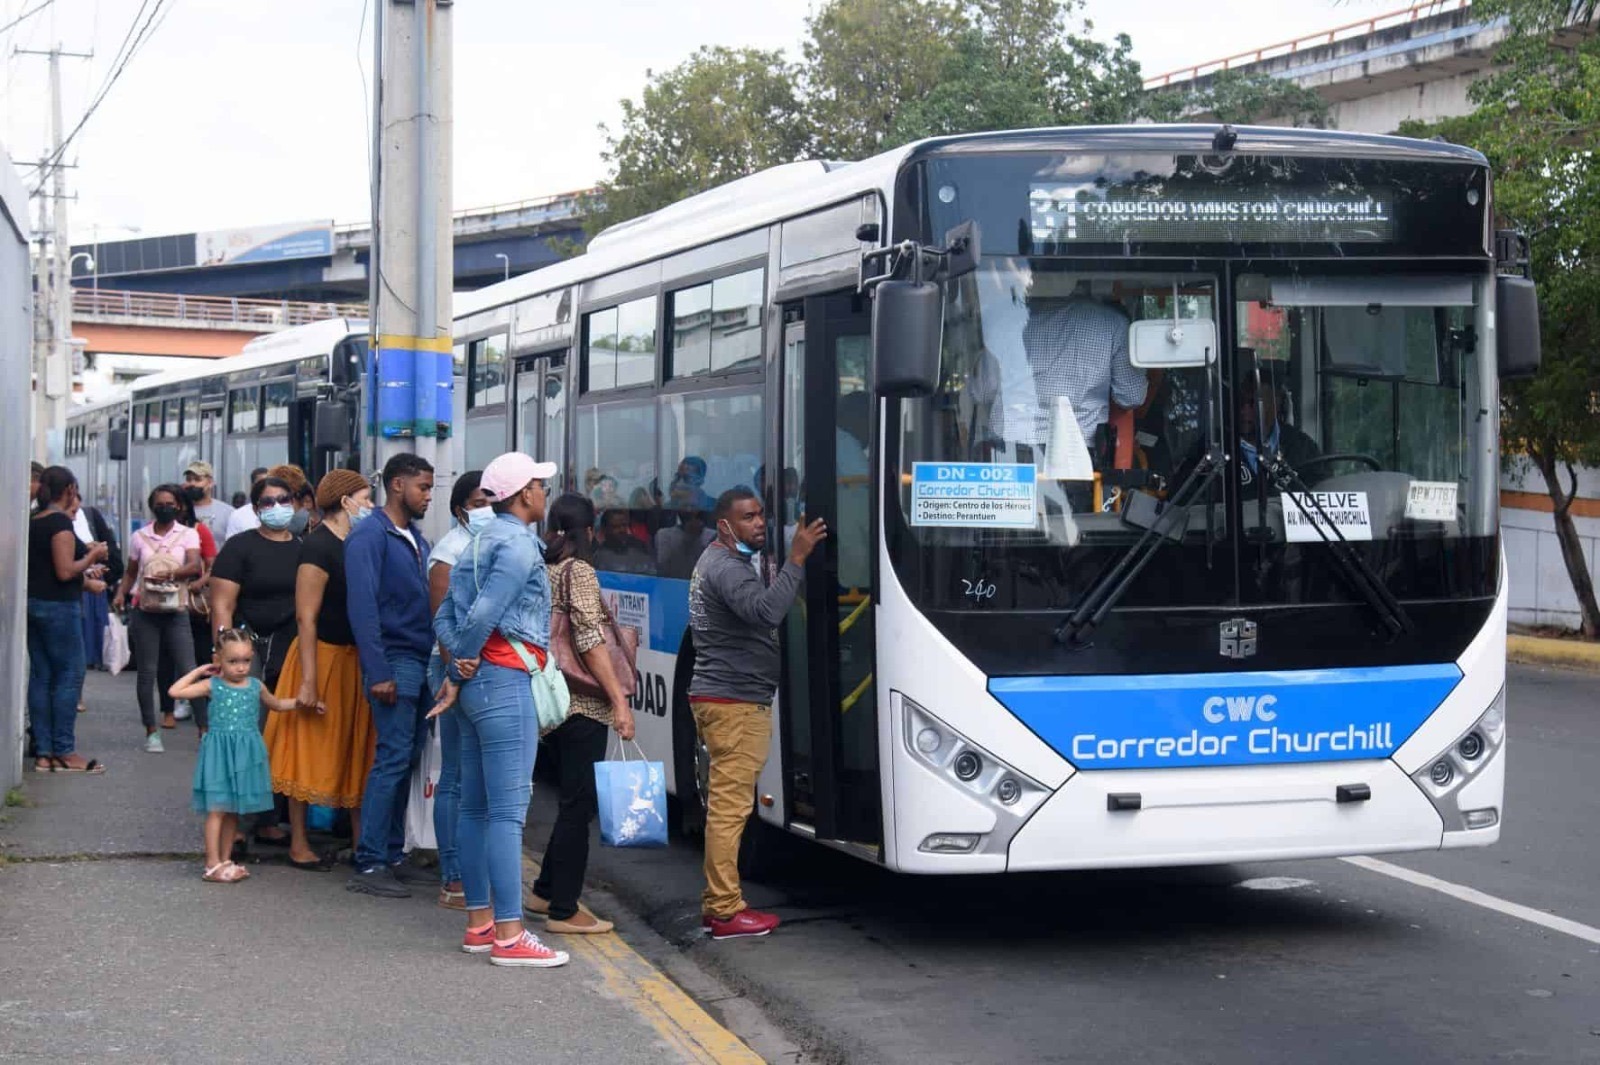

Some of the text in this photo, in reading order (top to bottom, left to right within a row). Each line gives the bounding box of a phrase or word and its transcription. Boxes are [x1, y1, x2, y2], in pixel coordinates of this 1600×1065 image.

[1083, 201, 1188, 221] CORREDOR
[1190, 201, 1278, 221] WINSTON
[1282, 201, 1389, 221] CHURCHILL
[937, 467, 966, 480] DN
[980, 468, 1014, 481] 002
[918, 484, 1030, 497] Corredor Churchill
[922, 501, 952, 511] Origen:
[952, 501, 979, 510] Centro
[980, 501, 991, 510] de
[991, 501, 1003, 510] los
[1292, 493, 1359, 508] VUELVE
[922, 511, 955, 520] Destino:
[1329, 511, 1368, 526] CHURCHILL
[1203, 694, 1278, 724] CWC
[1072, 722, 1393, 760] Corredor Churchill
